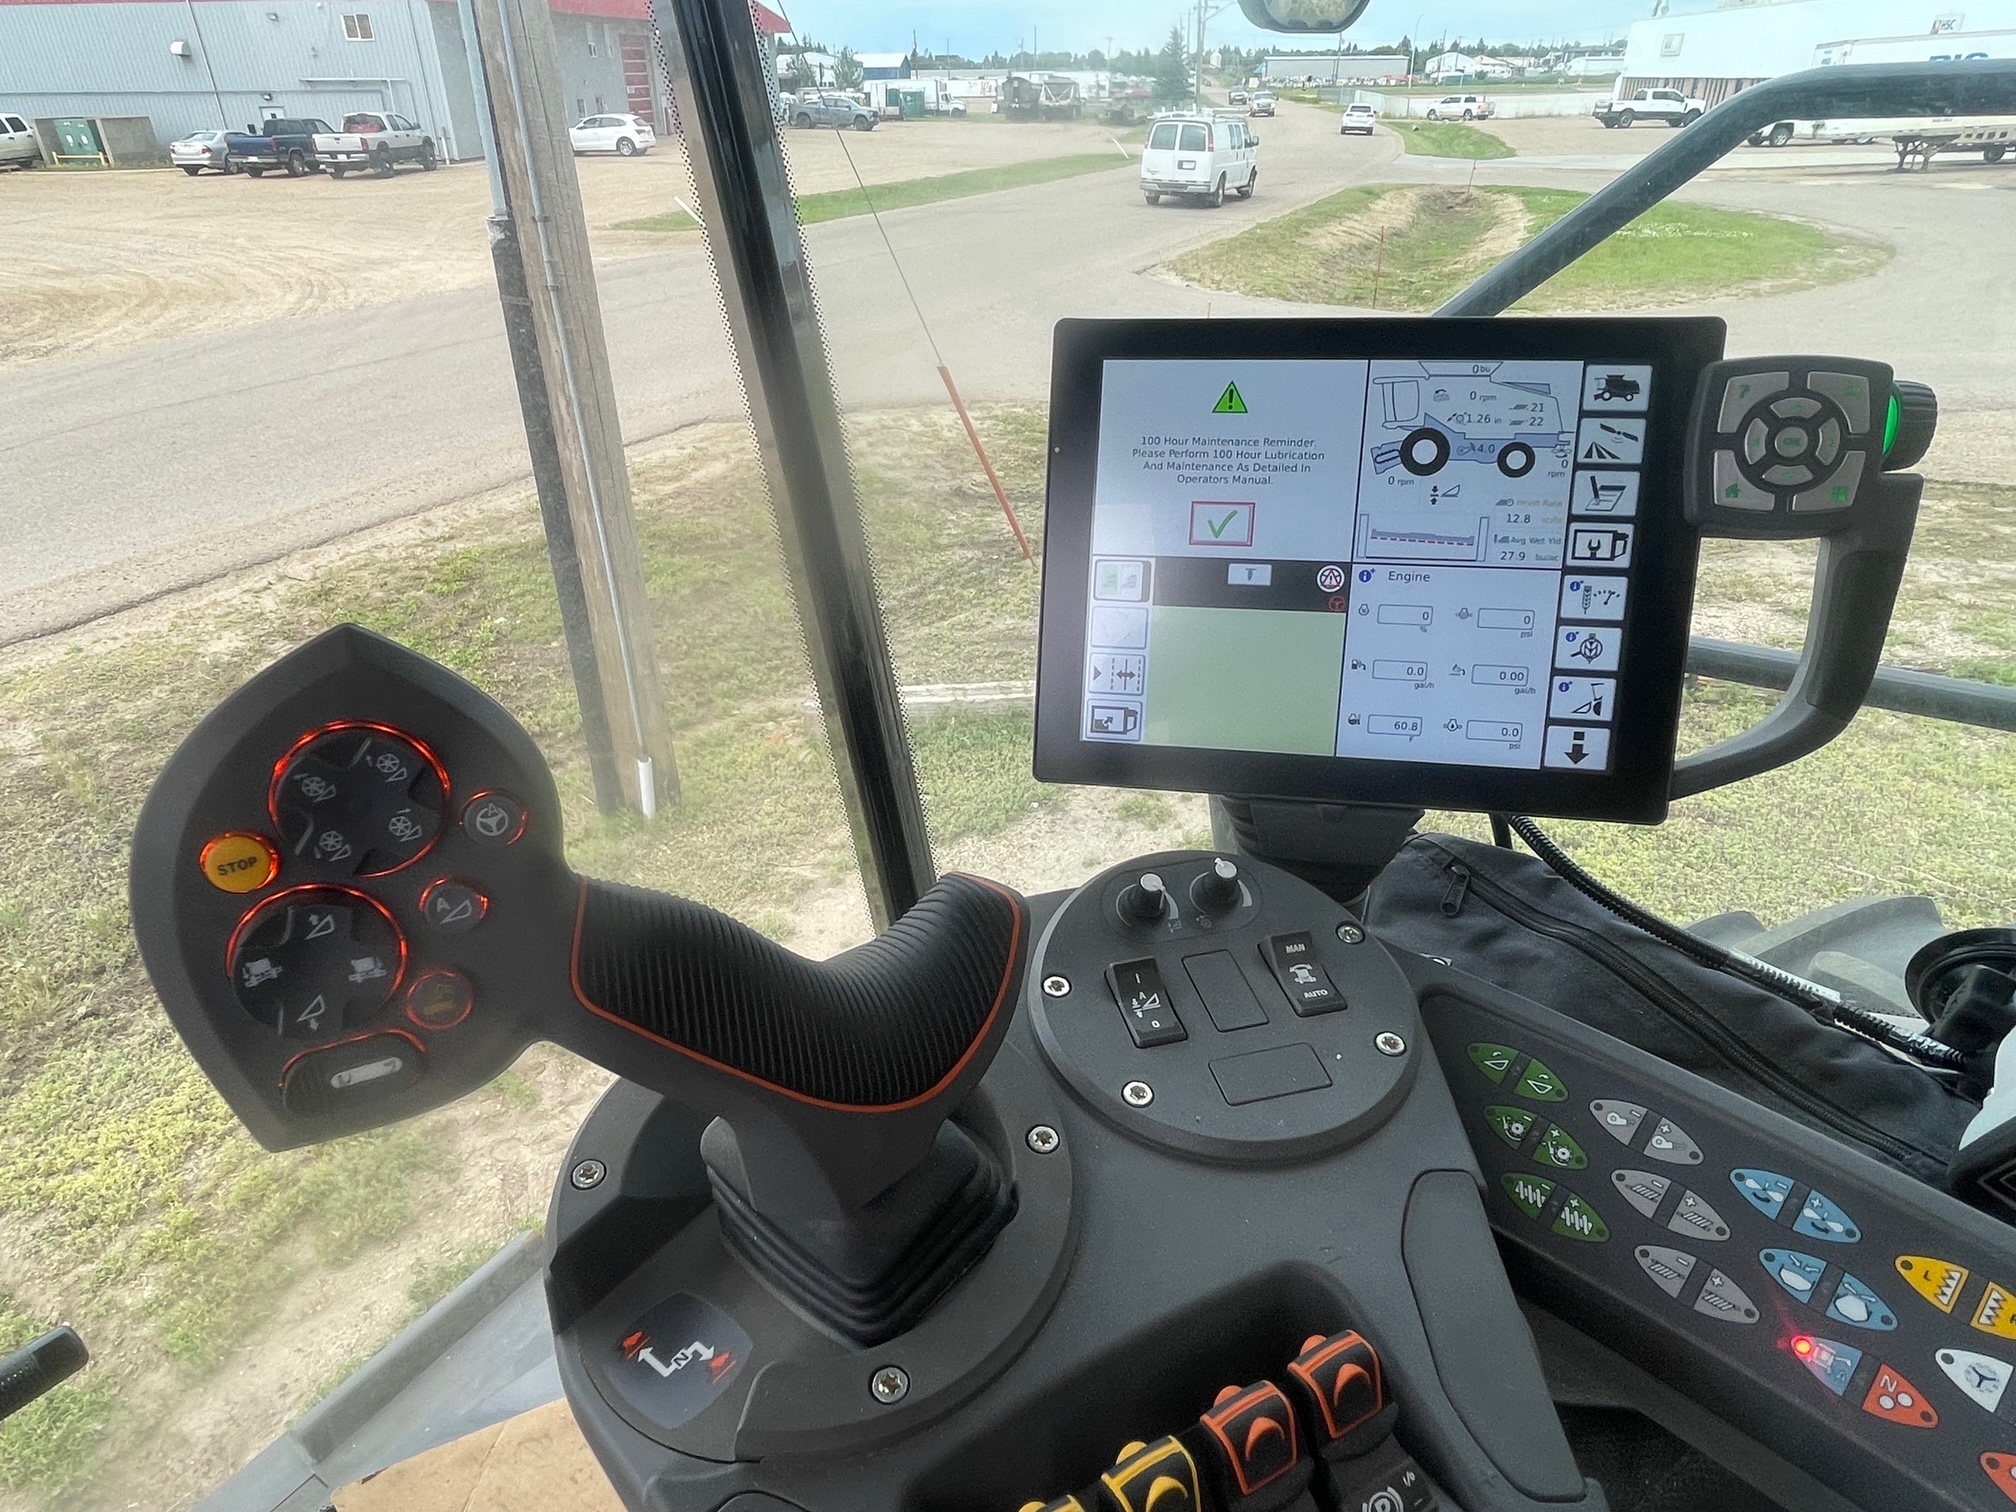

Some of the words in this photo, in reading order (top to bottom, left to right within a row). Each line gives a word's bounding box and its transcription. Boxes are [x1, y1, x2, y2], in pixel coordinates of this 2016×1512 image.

[1472, 364, 1480, 374] 0
[1480, 365, 1491, 373] bu
[1469, 390, 1477, 401] 0
[1479, 394, 1498, 403] rpm
[1530, 402, 1545, 413] 21
[1467, 413, 1491, 424] 1.26
[1528, 416, 1545, 427] 22
[1141, 435, 1161, 446] 100
[1163, 436, 1190, 446] Hour
[1191, 436, 1260, 447] Maintenance
[1263, 437, 1317, 448] Reminder.
[1132, 447, 1166, 458] Please
[1169, 448, 1210, 459] Perform
[1213, 449, 1233, 459] 100
[1236, 450, 1262, 460] Hour
[1264, 450, 1325, 461] Lubrication
[1476, 443, 1496, 454] 4.0
[1142, 460, 1164, 471] And
[1166, 461, 1234, 472] Maintenance
[1236, 462, 1250, 472] As
[1252, 462, 1298, 473] Detailed
[1300, 463, 1312, 473] In
[1561, 458, 1569, 469] 0
[1176, 473, 1230, 486] Operators
[1231, 475, 1274, 485] Manual.
[1547, 471, 1566, 479] rpm
[1387, 475, 1395, 486] 0
[1397, 479, 1415, 487] rpm
[1506, 513, 1531, 524] 12.8
[1511, 536, 1526, 546] Avg
[1500, 550, 1526, 561] 27.9
[1388, 570, 1431, 584] Engine
[1422, 611, 1430, 621] 0
[1523, 615, 1531, 625] 0
[1520, 631, 1534, 639] psi
[1406, 666, 1425, 676] 0.0
[1499, 671, 1525, 682] 0.00
[1514, 687, 1537, 696] gal/h
[1394, 721, 1418, 732] 60.8
[1501, 727, 1519, 737] 0.0
[217, 856, 258, 876] STOP
[1285, 943, 1306, 954] MAN
[1303, 988, 1329, 999] AUTO
[1880, 1374, 1898, 1393] N
